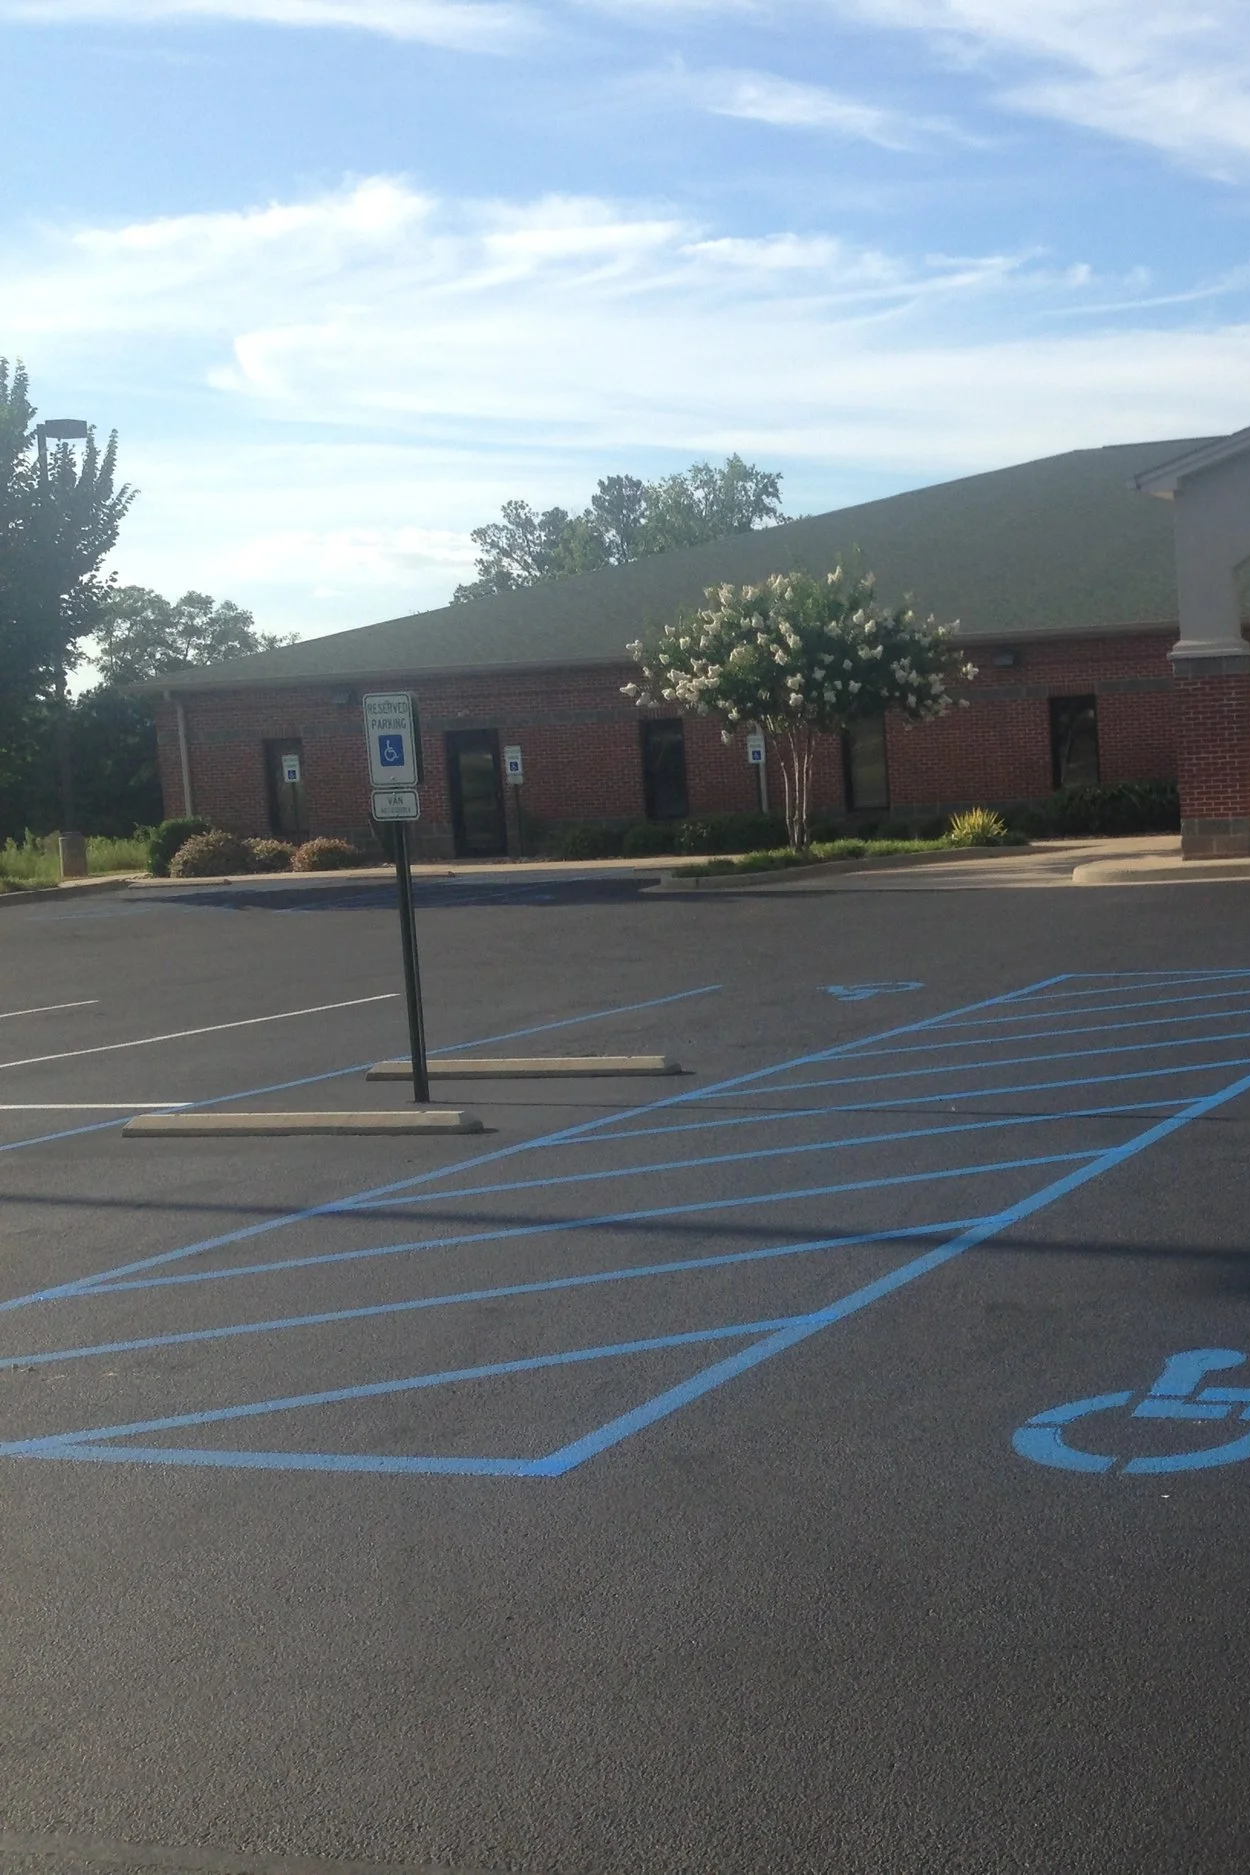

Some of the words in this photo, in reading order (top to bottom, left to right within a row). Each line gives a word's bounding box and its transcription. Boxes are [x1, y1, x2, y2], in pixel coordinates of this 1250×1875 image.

[367, 702, 408, 715] RESERVED
[371, 717, 407, 730] PARKING
[387, 796, 404, 805] VAN
